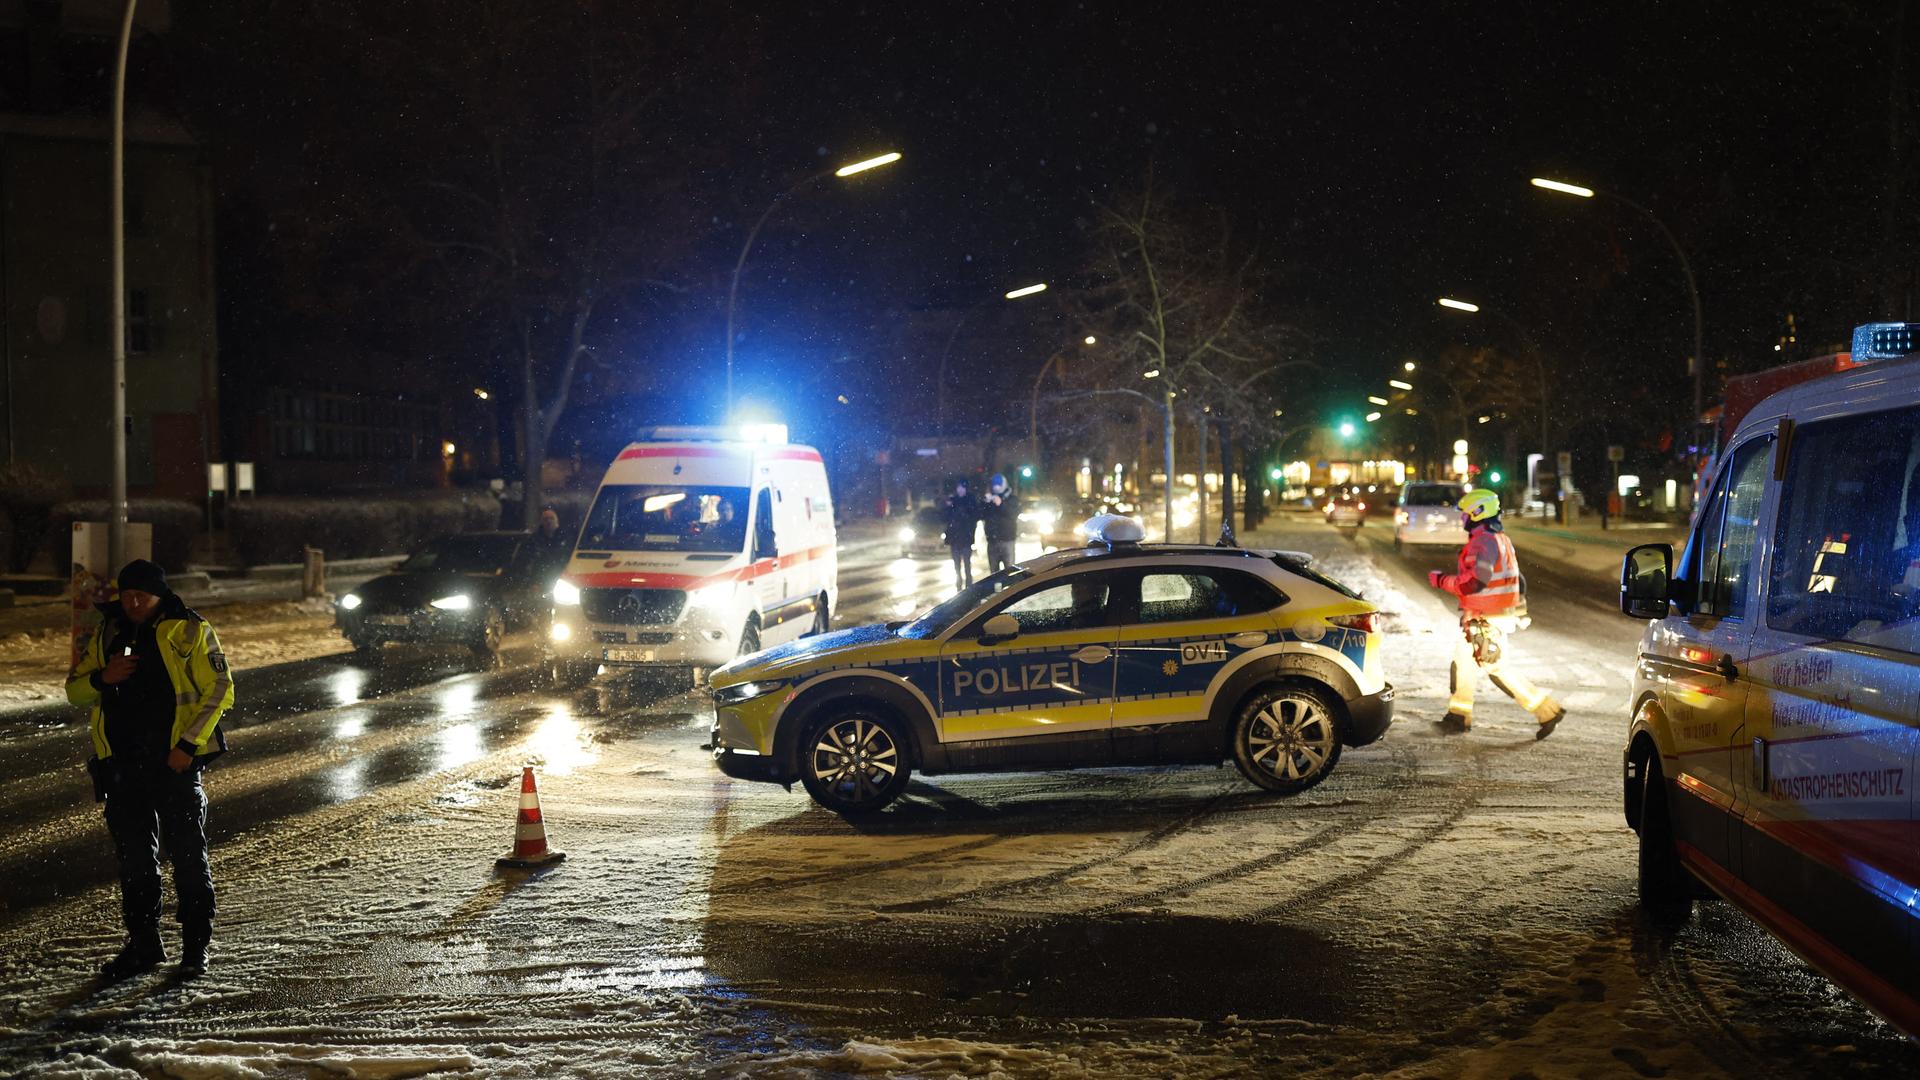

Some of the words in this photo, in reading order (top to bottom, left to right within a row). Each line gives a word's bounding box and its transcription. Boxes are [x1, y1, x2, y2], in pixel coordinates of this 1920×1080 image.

[1182, 643, 1211, 661] OV
[1213, 641, 1223, 659] 4
[1346, 635, 1366, 648] 110
[954, 662, 1080, 697] POLIZEI
[1772, 664, 1792, 687] Wir
[1794, 655, 1833, 687] helfen
[1771, 701, 1793, 728] hier
[1770, 768, 1904, 801] KATASTROPHENSCHUTZ
